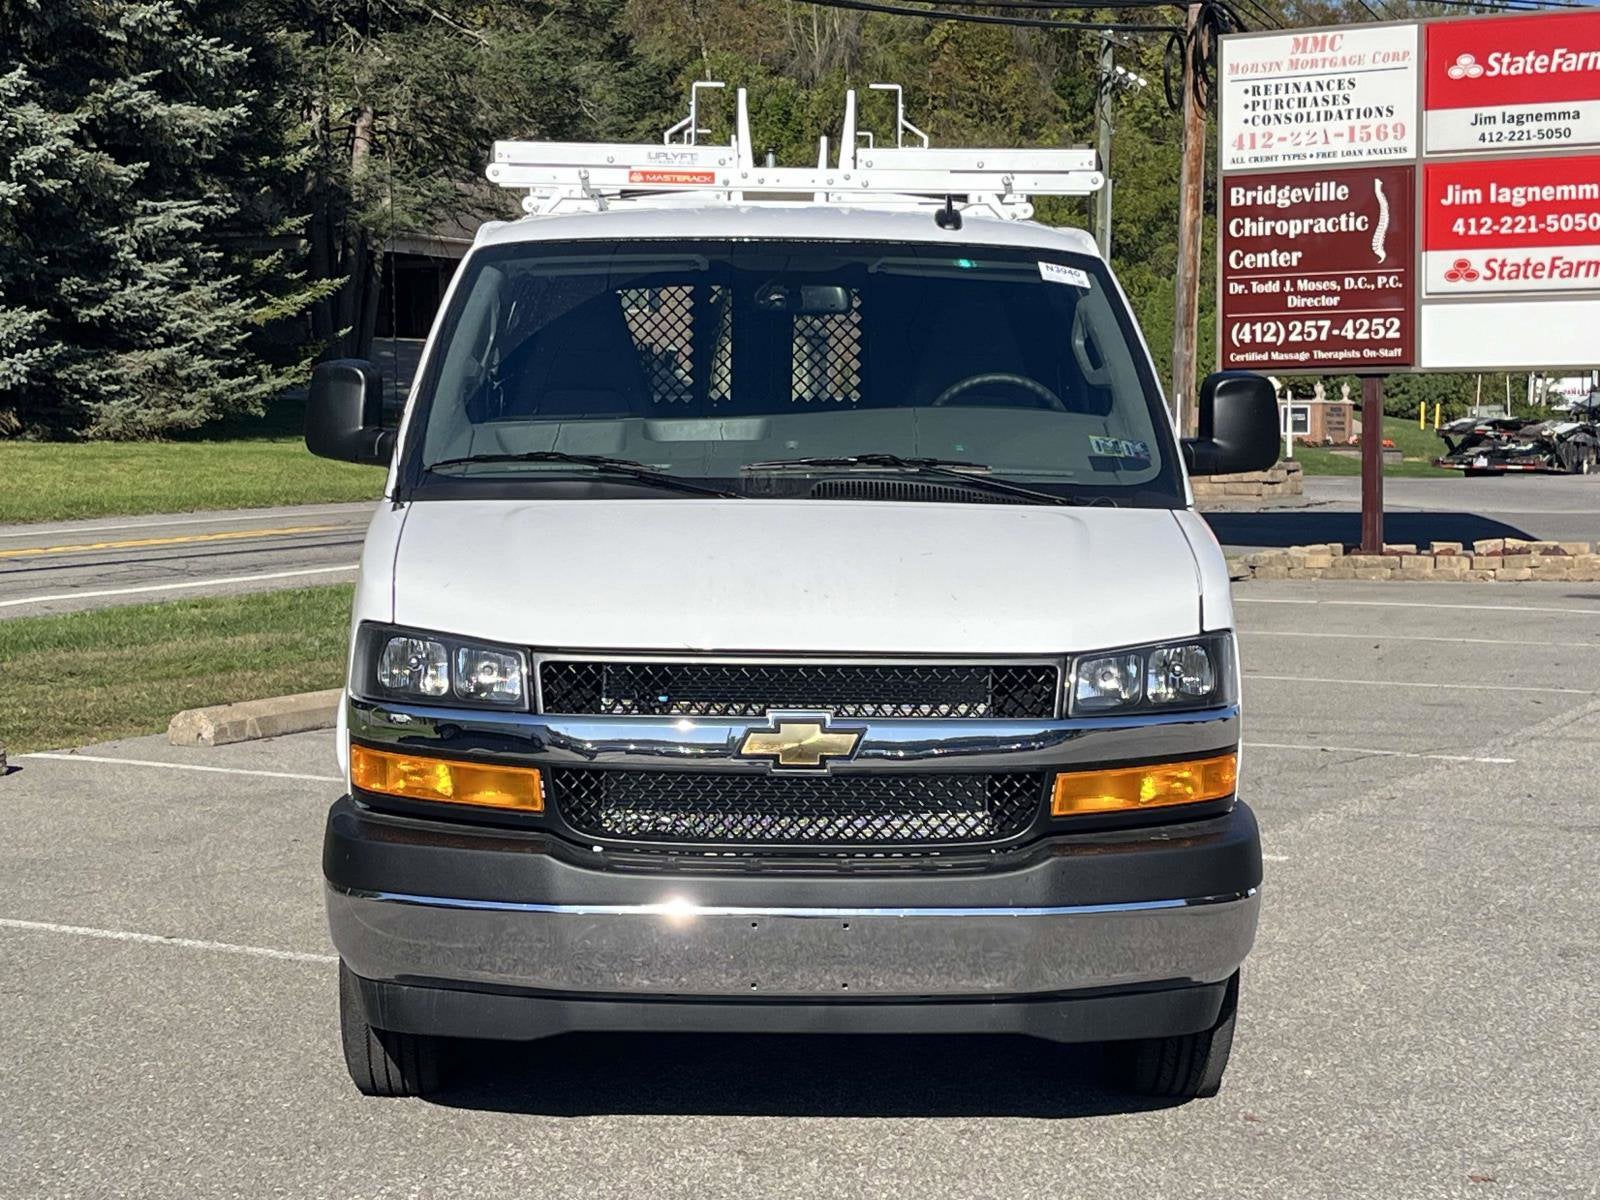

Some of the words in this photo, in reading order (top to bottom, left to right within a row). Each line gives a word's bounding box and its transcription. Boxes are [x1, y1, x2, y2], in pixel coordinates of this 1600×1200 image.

[1291, 33, 1344, 55] MMC
[1287, 55, 1366, 71] MORTGAGE
[1251, 77, 1356, 97] REFINANCES
[1251, 93, 1351, 112] PURCHASES
[1251, 105, 1394, 127] CONSOLIDATIONS
[1470, 113, 1496, 126] Jim
[1232, 122, 1406, 150] 412-221-1569
[1479, 127, 1571, 143] 412-221-5050
[1248, 154, 1278, 163] CREDIT
[1282, 152, 1307, 162] TYPES
[1315, 150, 1338, 159] FREE
[1341, 148, 1363, 157] LOAN
[1367, 146, 1407, 156] ANALYSIS
[646, 174, 711, 182] MASTERACK
[1230, 181, 1349, 208] Bridgeville
[1441, 184, 1482, 206] Jim
[1490, 182, 1600, 207] Iagnemm
[1229, 211, 1369, 238] Chiropractic
[1452, 212, 1600, 236] 412-221-5050
[1229, 249, 1302, 269] Center
[1229, 282, 1248, 294] Dr.
[1250, 280, 1280, 293] Todd
[1283, 279, 1294, 292] J.
[1297, 277, 1341, 292] Moses,
[1287, 295, 1340, 308] Director
[1231, 320, 1286, 348] (412)
[1288, 317, 1401, 342] 257-4252
[1230, 351, 1268, 362] Certified
[1271, 350, 1310, 361] Massage
[1313, 349, 1361, 360] Therapists
[1363, 348, 1403, 358] On-Staff
